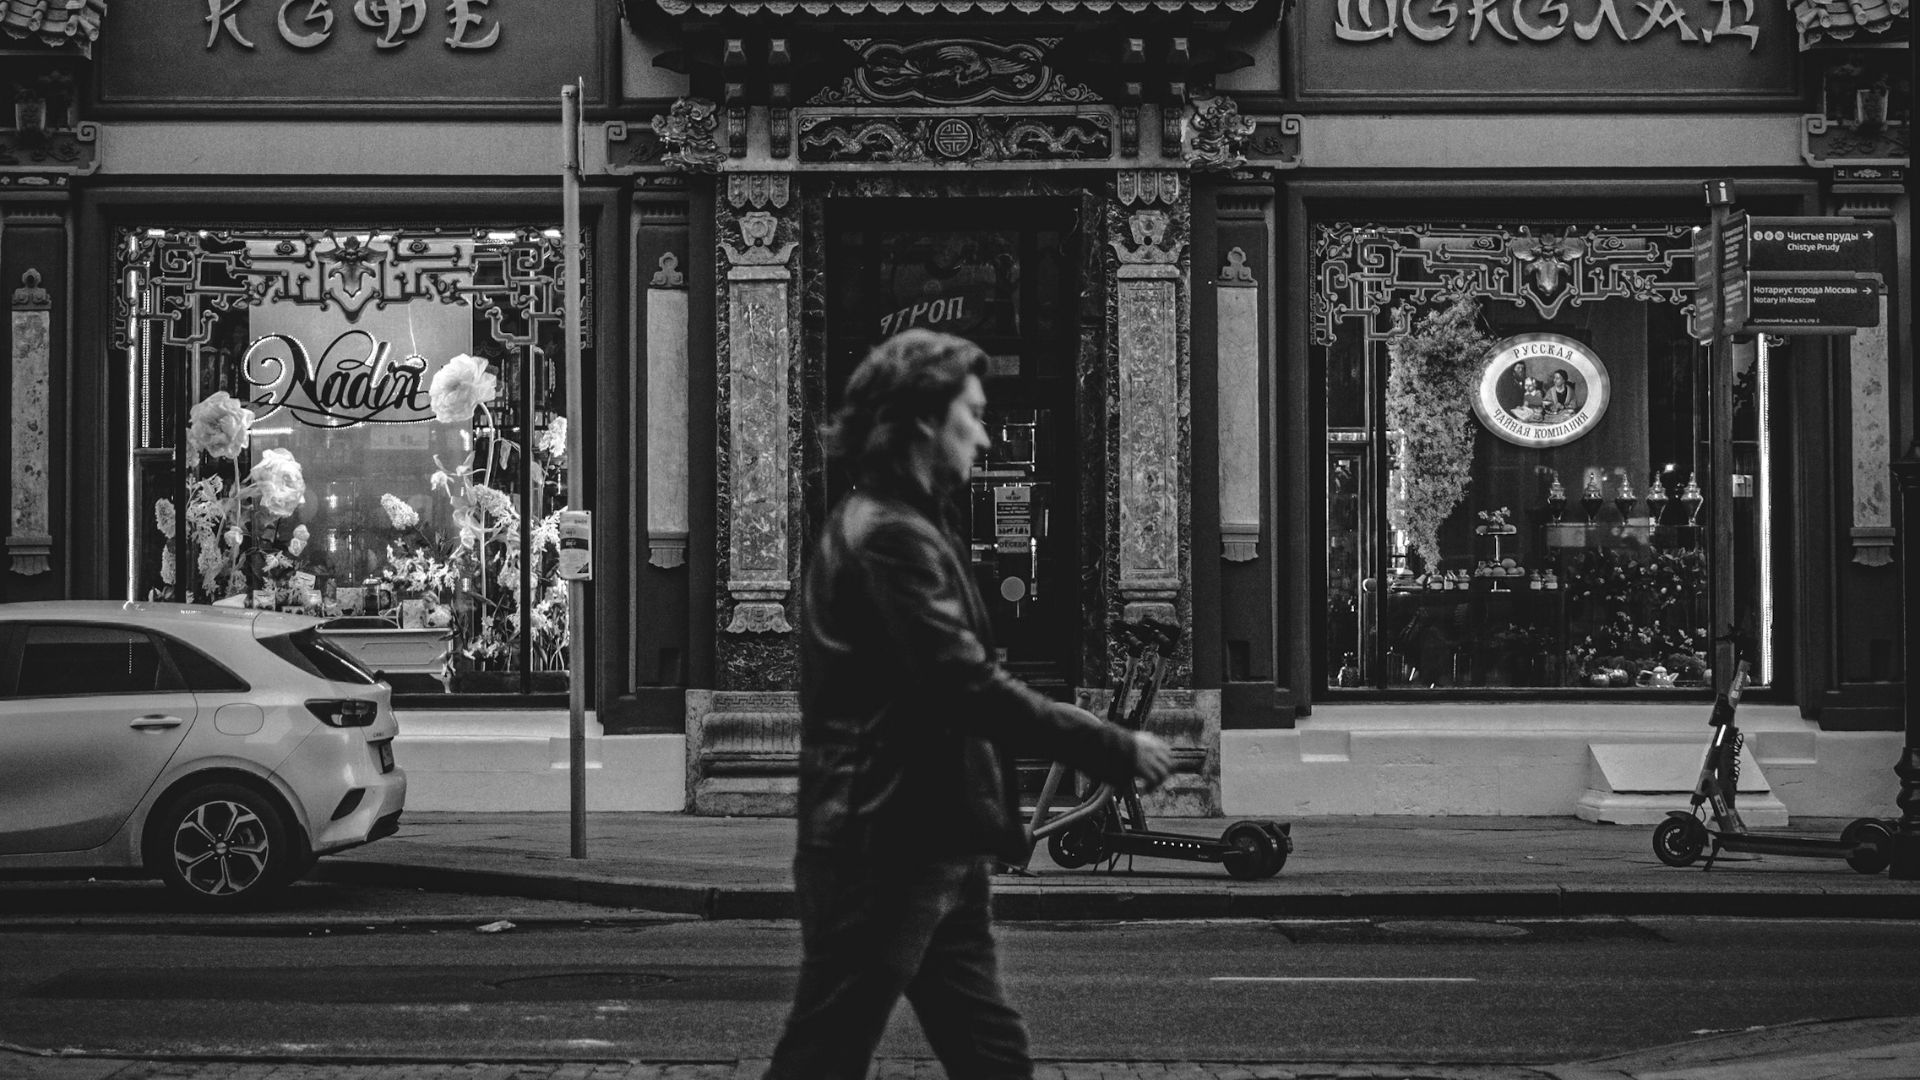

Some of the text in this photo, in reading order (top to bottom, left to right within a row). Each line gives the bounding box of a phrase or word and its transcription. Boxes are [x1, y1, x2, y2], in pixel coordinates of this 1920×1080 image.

[1787, 231, 1824, 241] Чистые
[1826, 232, 1859, 243] пруды
[1787, 243, 1840, 252] Chistye Prudy
[1753, 286, 1857, 295] Нотариус города Москвы
[1753, 296, 1778, 304] Notary
[1787, 296, 1817, 304] Moscow
[1513, 344, 1574, 361] РУССКАЯ
[242, 329, 437, 429] Nadin
[1493, 408, 1589, 439] ЧАЙНАЯ КОМПАНИЯ
